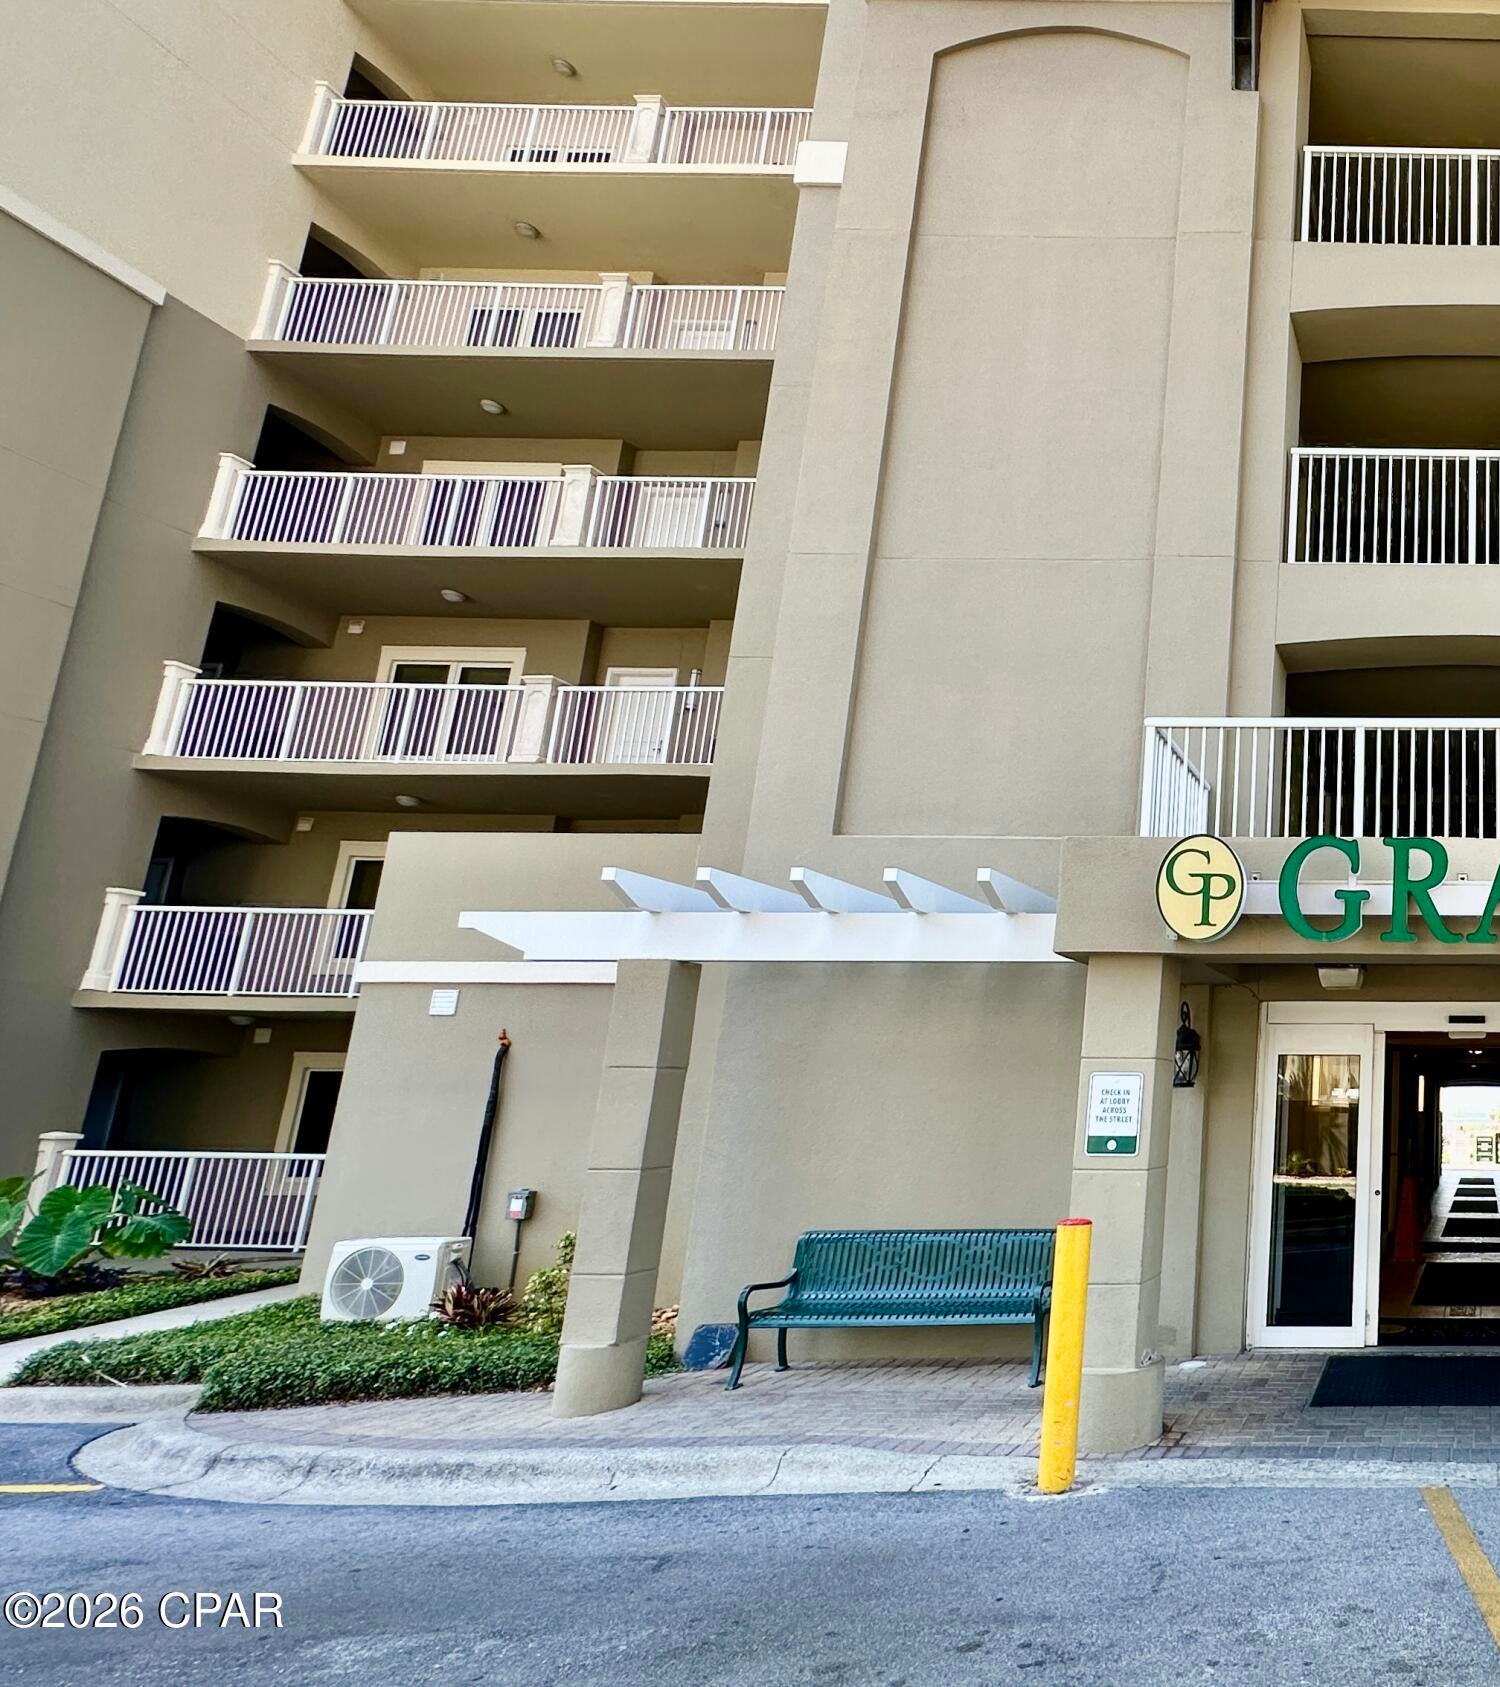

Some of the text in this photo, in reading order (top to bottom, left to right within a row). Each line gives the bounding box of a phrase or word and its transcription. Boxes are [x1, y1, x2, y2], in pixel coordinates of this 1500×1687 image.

[1123, 1088, 1131, 1096] IN
[1100, 1097, 1131, 1105] AT LOBBY
[1102, 1106, 1127, 1114] ACROSS
[1095, 1115, 1133, 1123] THE STREET
